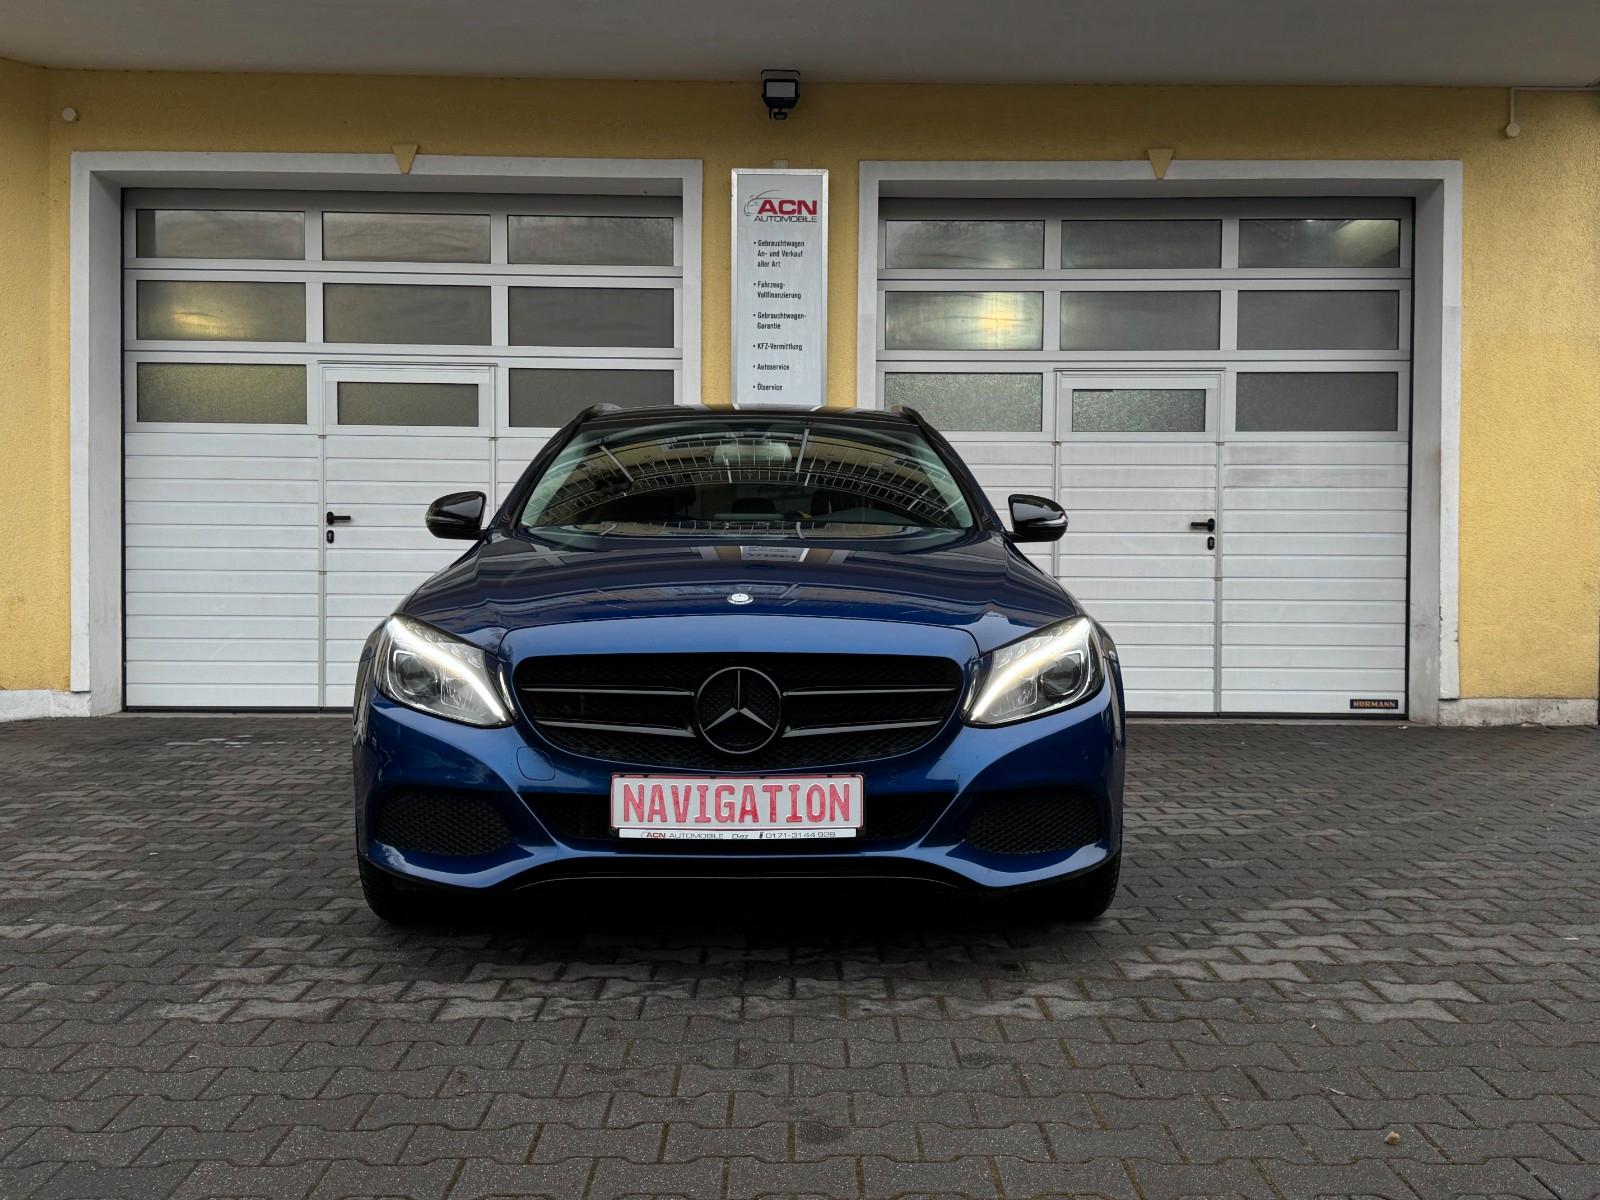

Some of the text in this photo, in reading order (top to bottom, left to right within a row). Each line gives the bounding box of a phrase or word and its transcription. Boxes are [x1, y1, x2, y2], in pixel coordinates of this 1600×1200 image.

[757, 199, 818, 215] ACN
[754, 215, 817, 223] AUTOMOBILE
[757, 240, 805, 249] Gebrauchtwagen
[757, 260, 781, 268] aller Art
[757, 291, 802, 300] Vollfinanzierung
[757, 343, 803, 351] KFZ-Vermittlung
[622, 783, 851, 823] NAVIGATION
